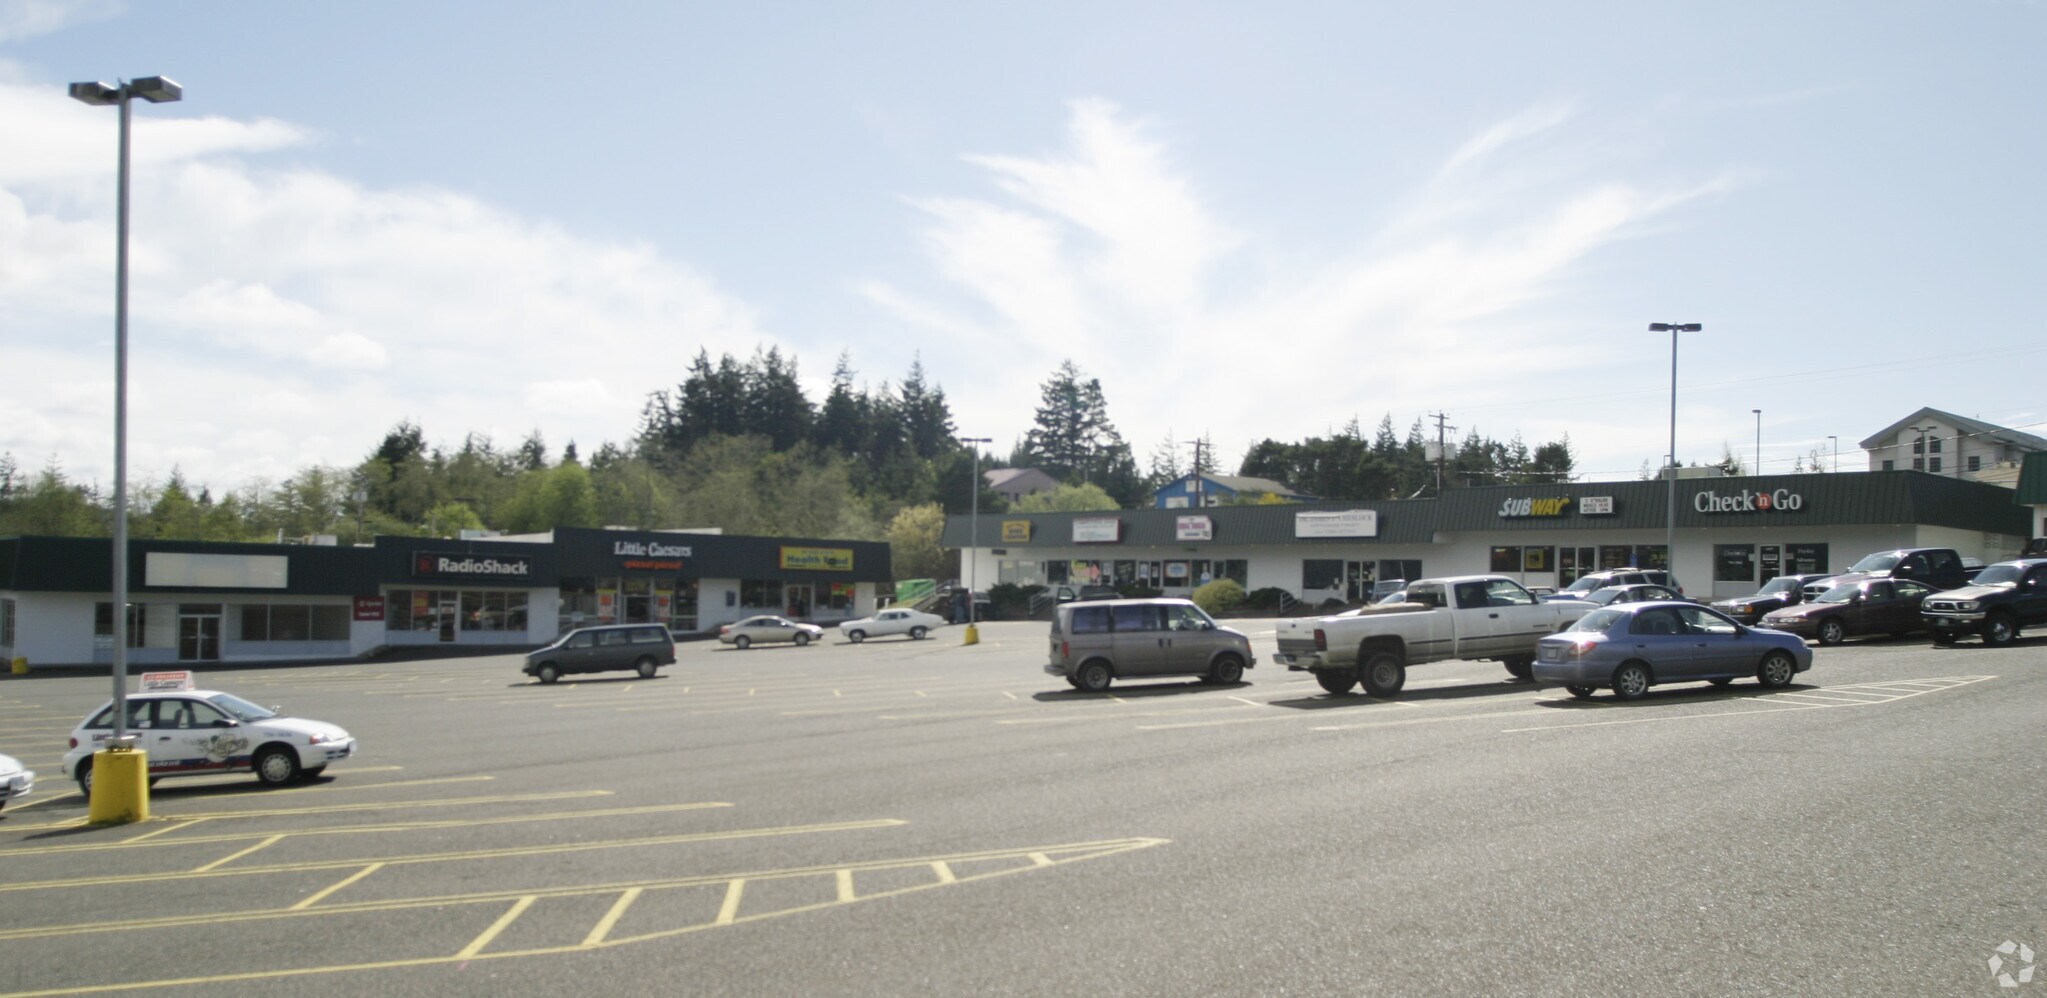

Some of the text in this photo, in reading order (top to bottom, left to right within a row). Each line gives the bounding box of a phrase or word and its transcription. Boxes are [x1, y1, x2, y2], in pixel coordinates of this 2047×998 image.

[1498, 497, 1570, 517] SUBWAY
[1694, 488, 1756, 512] Check
[1772, 488, 1802, 511] Go
[614, 541, 692, 557] Little Caesars
[438, 557, 528, 575] RadioShack
[787, 555, 821, 564] Health
